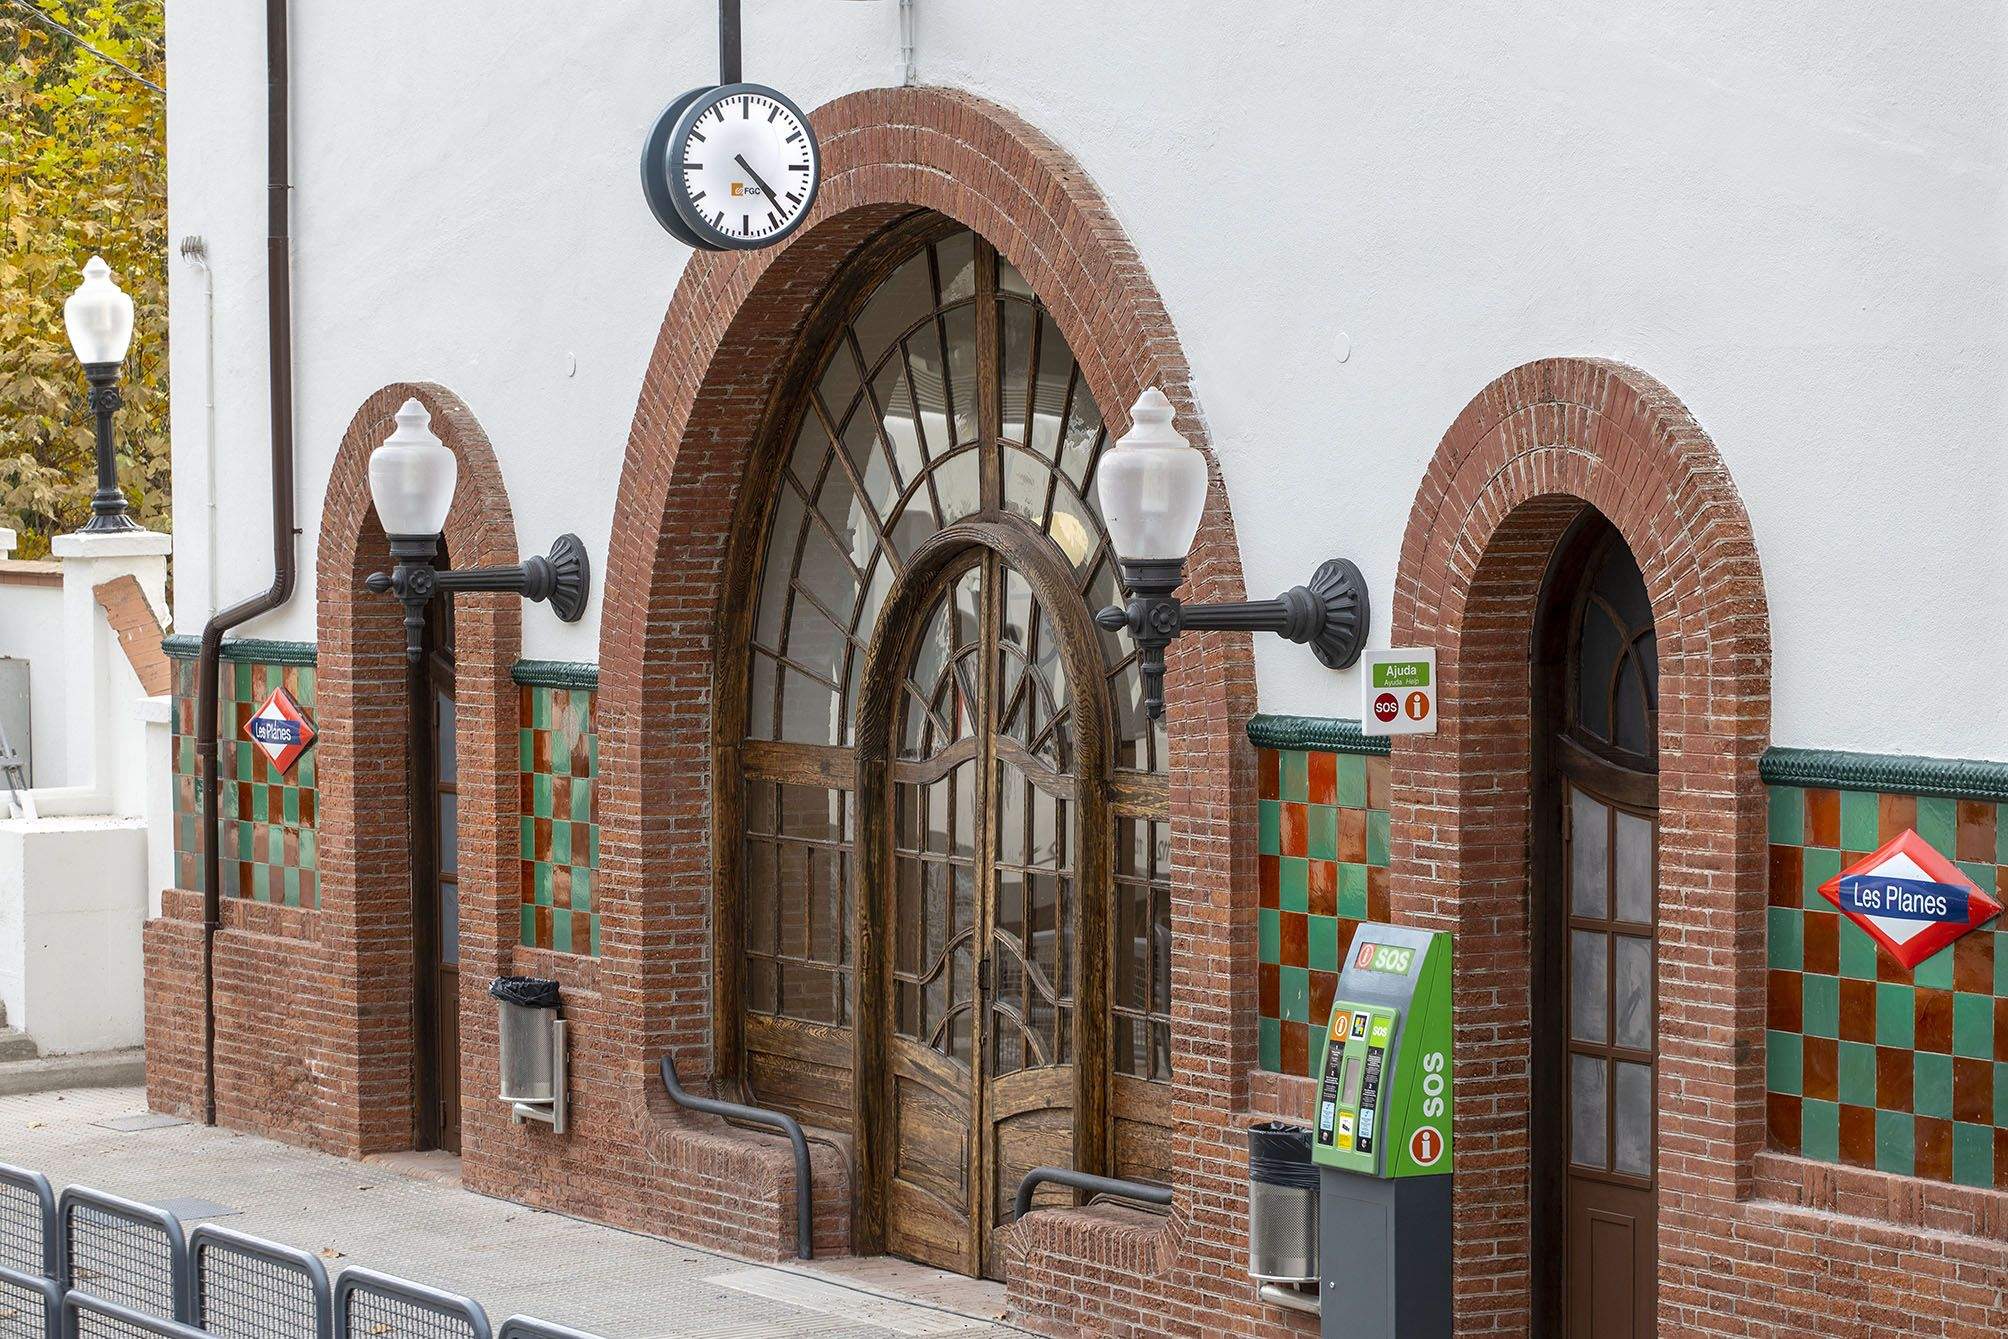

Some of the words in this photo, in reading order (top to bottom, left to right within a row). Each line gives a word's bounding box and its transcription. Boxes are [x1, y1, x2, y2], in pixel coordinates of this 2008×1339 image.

[744, 187, 761, 195] FGC
[1386, 665, 1417, 678] Ajuda
[1384, 679, 1403, 688] Ayuda
[1405, 678, 1420, 686] Help
[1375, 702, 1398, 713] SOS
[256, 722, 266, 739] Les
[266, 722, 292, 741] Planes
[1854, 881, 1880, 909] Les
[1886, 885, 1947, 915] Planes
[1375, 947, 1411, 972] SOS
[1372, 1026, 1388, 1037] SOS
[1423, 1051, 1445, 1118] SOS
